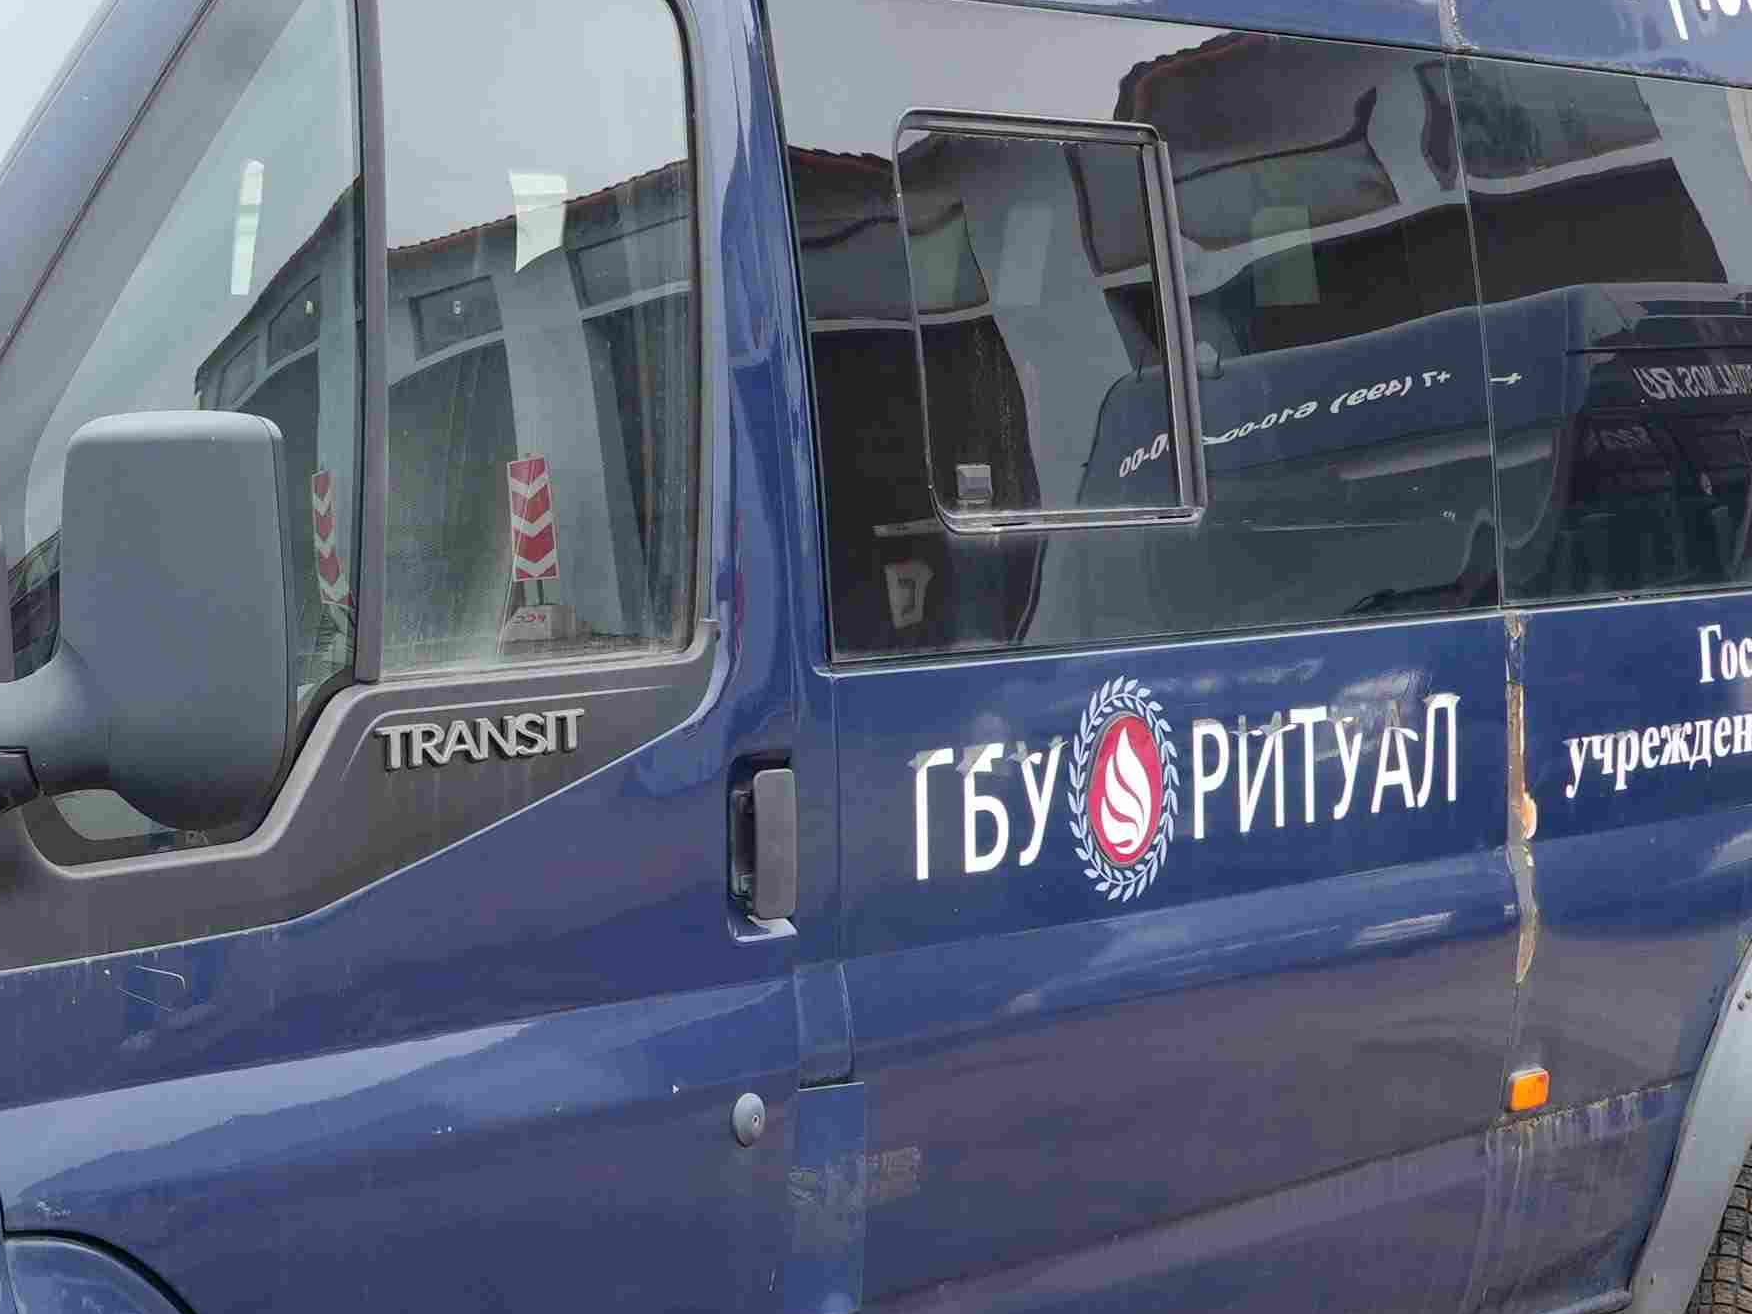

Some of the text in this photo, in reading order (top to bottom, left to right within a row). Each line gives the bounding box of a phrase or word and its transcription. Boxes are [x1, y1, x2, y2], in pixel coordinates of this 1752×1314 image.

[376, 708, 584, 771] TRANSIT
[907, 692, 1460, 880] ГБУ РИТУАЛ
